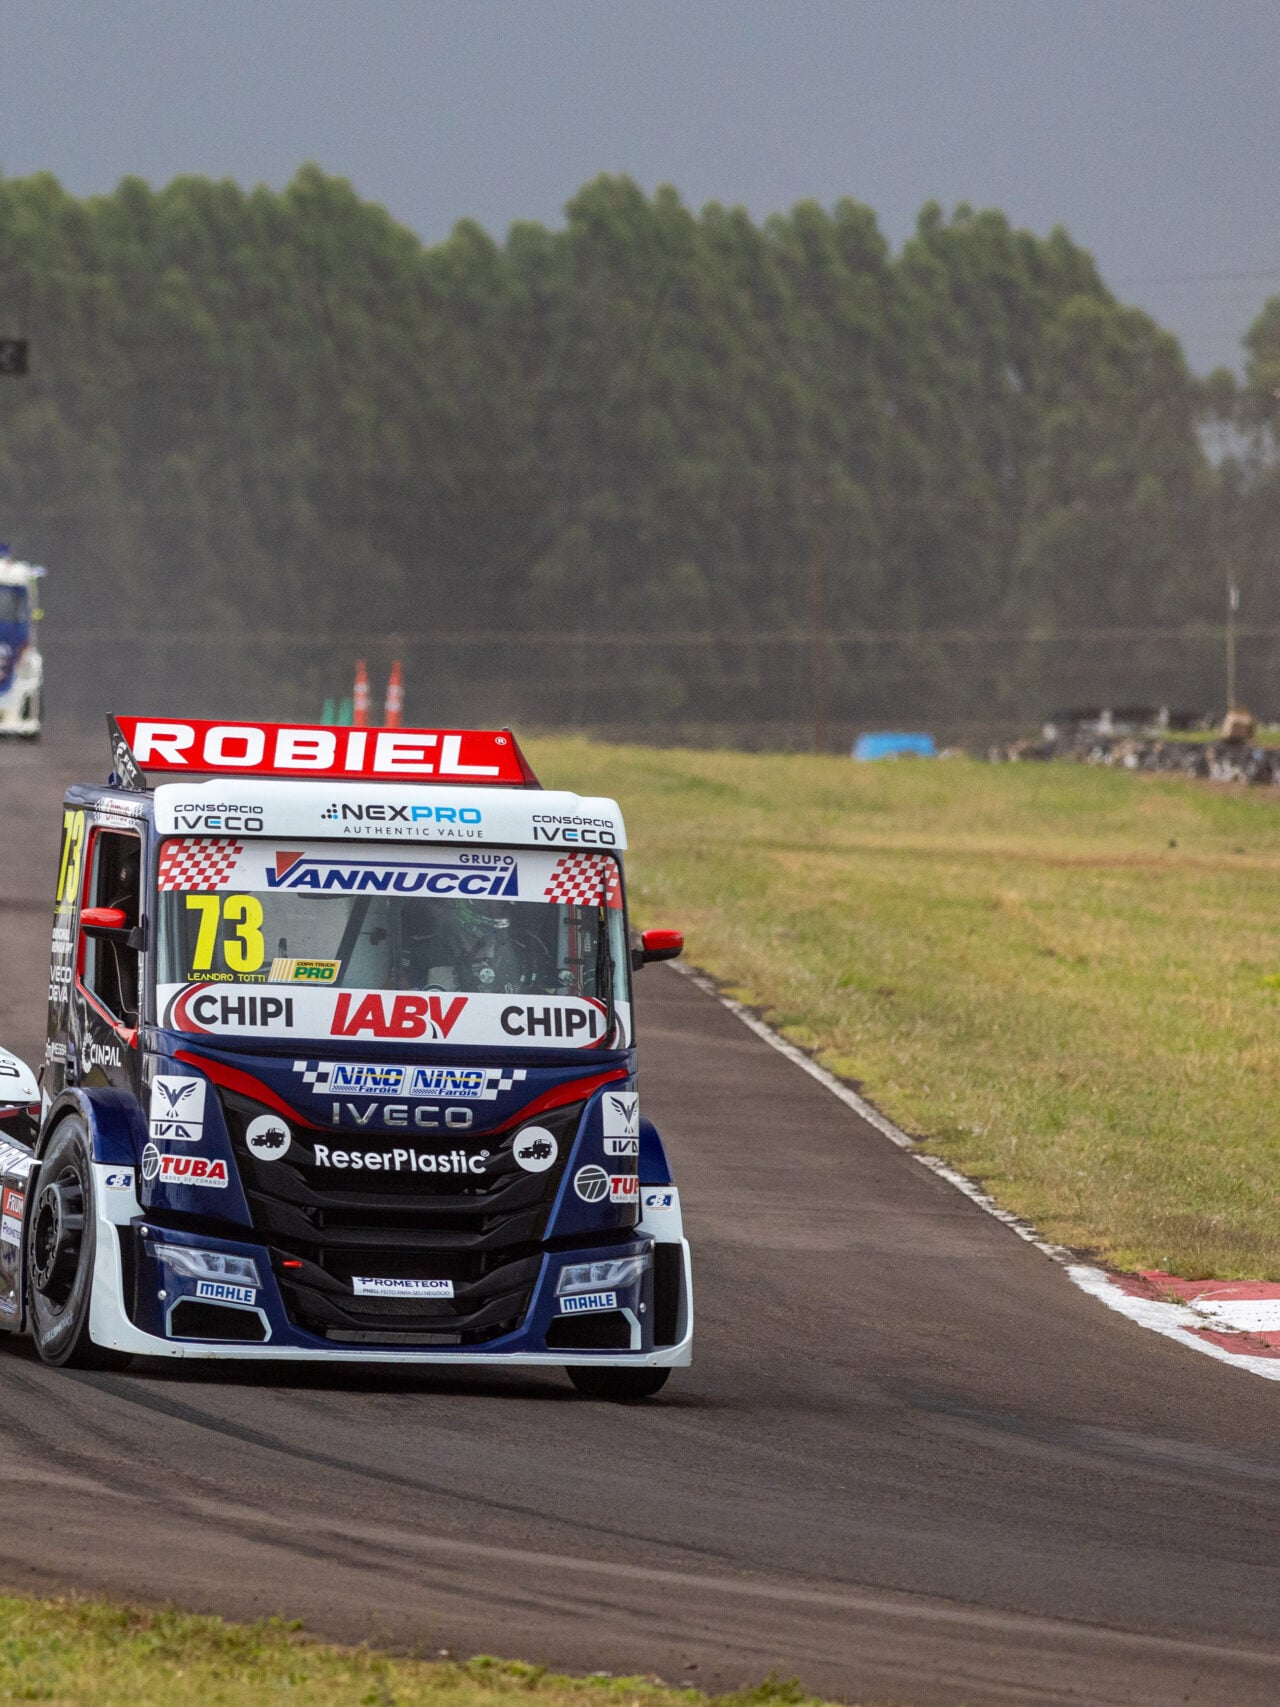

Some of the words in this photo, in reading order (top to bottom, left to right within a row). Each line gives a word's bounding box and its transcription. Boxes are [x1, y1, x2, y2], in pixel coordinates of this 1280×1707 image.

[133, 722, 500, 777] ROBIEL
[174, 802, 264, 814] CONSÓRCIO
[342, 803, 482, 825] NEXPRO
[174, 815, 264, 832] IVECO
[532, 814, 614, 829] CONSÓRCIO
[343, 826, 431, 837] AUTHENTIC
[437, 828, 483, 839] VALUE
[533, 826, 616, 846] IVECO
[56, 810, 85, 903] 73
[459, 853, 514, 866] GRUPO
[186, 894, 265, 973] 73
[187, 972, 234, 982] LEANDRO
[237, 973, 266, 983] TOTTI
[293, 966, 334, 979] PRO
[193, 994, 294, 1028] CHIPI
[500, 1005, 598, 1039] CHIPI
[90, 1043, 122, 1067] CINPAL
[332, 1102, 473, 1129] IVECO
[161, 1156, 226, 1180] TUBA
[199, 1282, 253, 1303] MAHLE
[357, 1277, 449, 1288] PROMETEON
[563, 1294, 614, 1311] MAHLE
